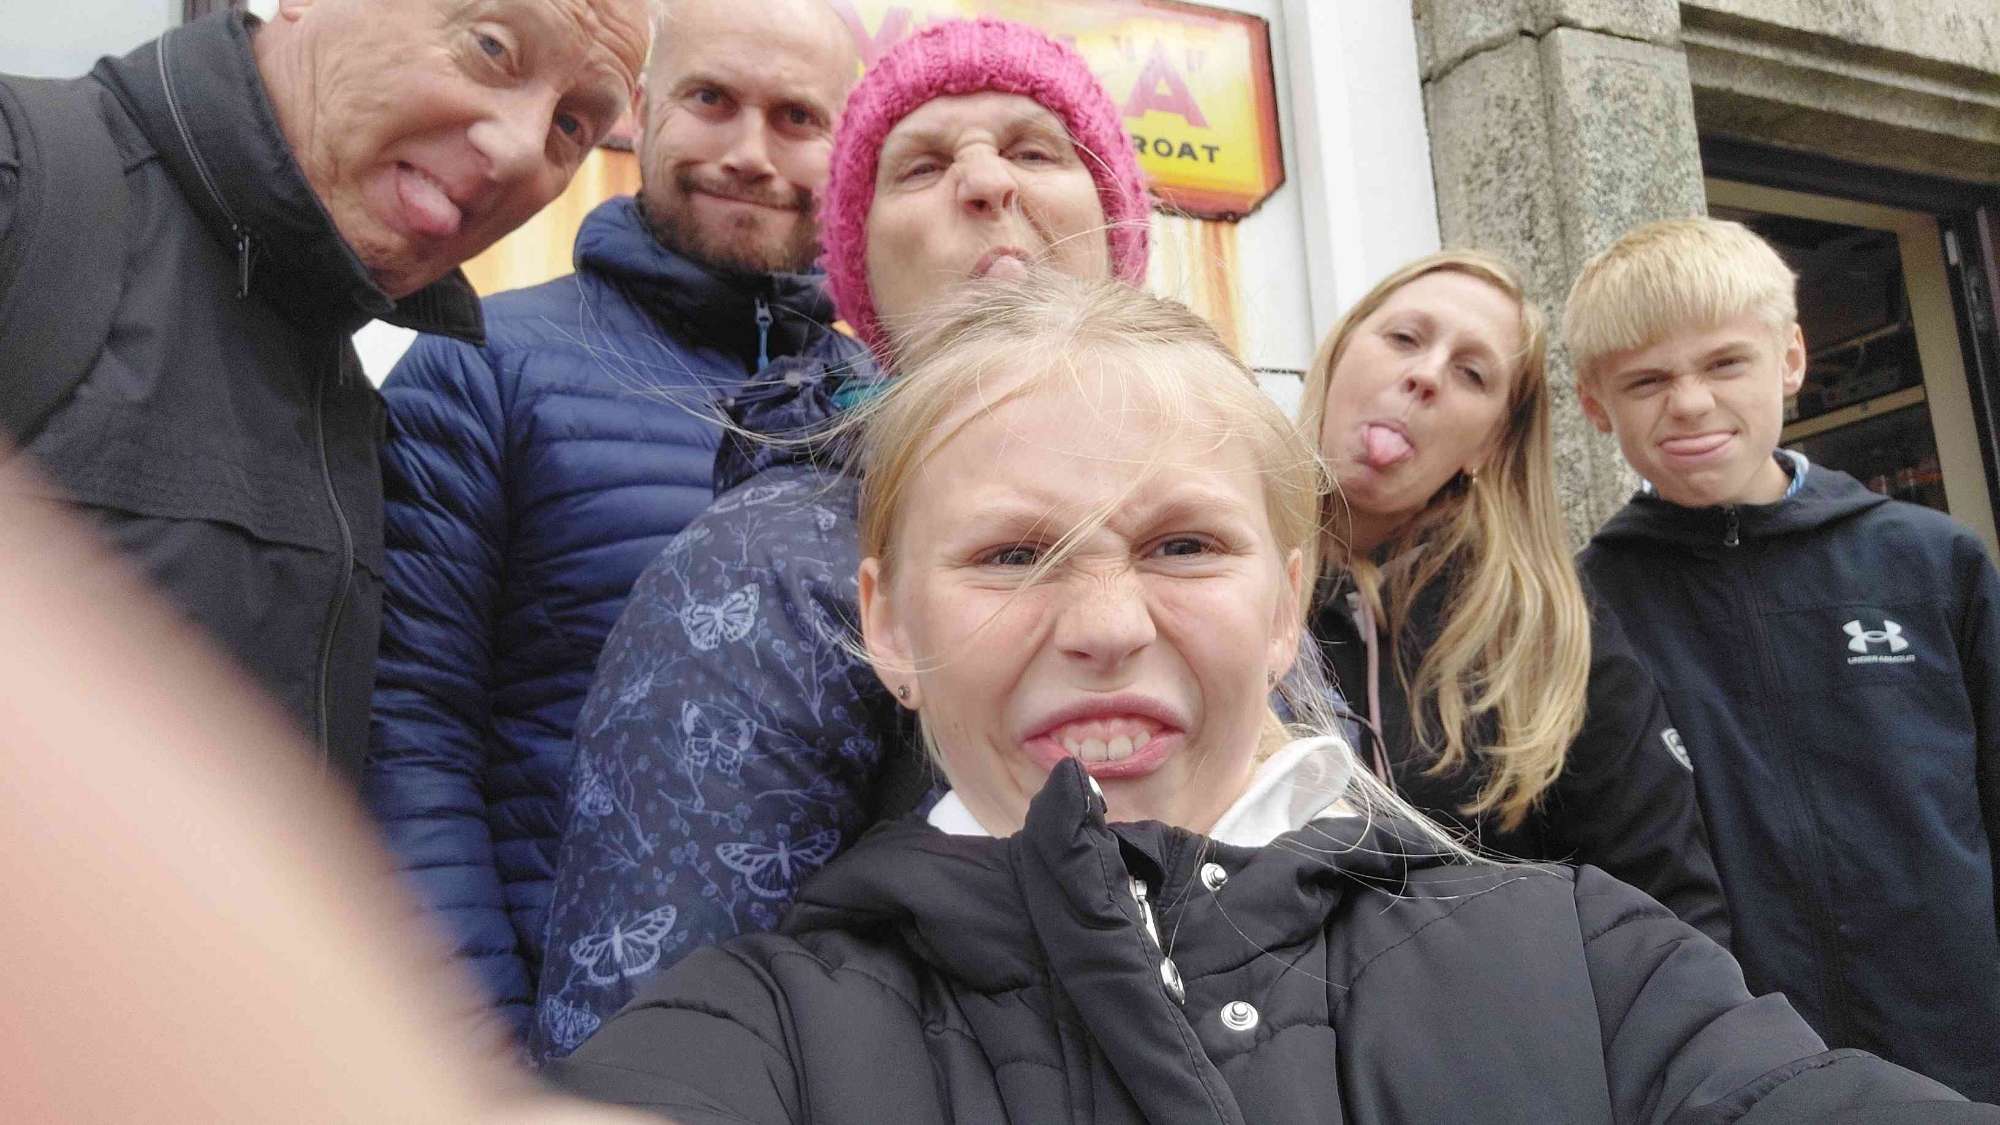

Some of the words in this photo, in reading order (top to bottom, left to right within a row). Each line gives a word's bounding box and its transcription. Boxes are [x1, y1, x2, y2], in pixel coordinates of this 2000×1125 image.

[1131, 134, 1220, 163] ROAT
[1847, 655, 1878, 665] UNDER
[1878, 654, 1916, 664] ARMOUR
